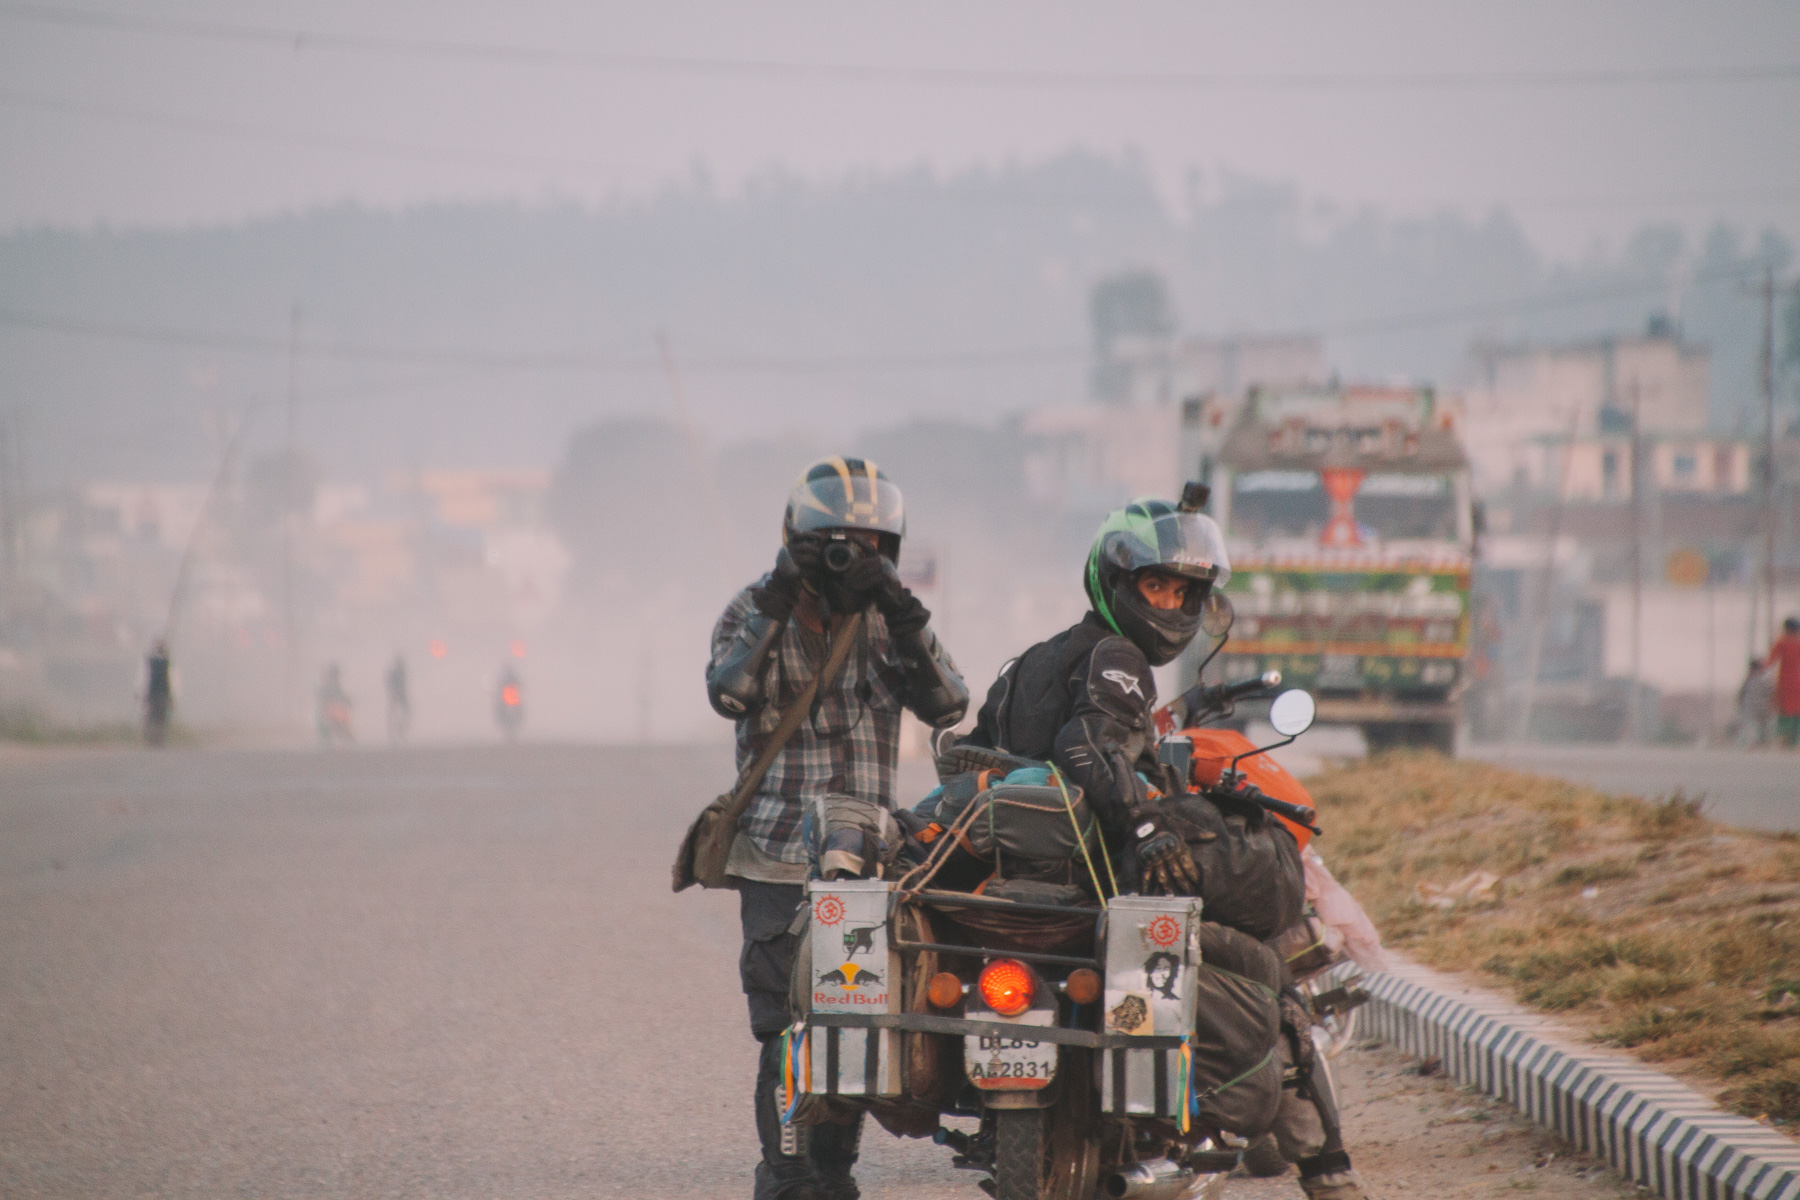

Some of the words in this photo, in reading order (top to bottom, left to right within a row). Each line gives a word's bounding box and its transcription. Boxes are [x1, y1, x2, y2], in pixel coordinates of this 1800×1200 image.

[814, 992, 850, 1004] Red
[853, 993, 888, 1004] Bull
[972, 1061, 1050, 1078] A2831
